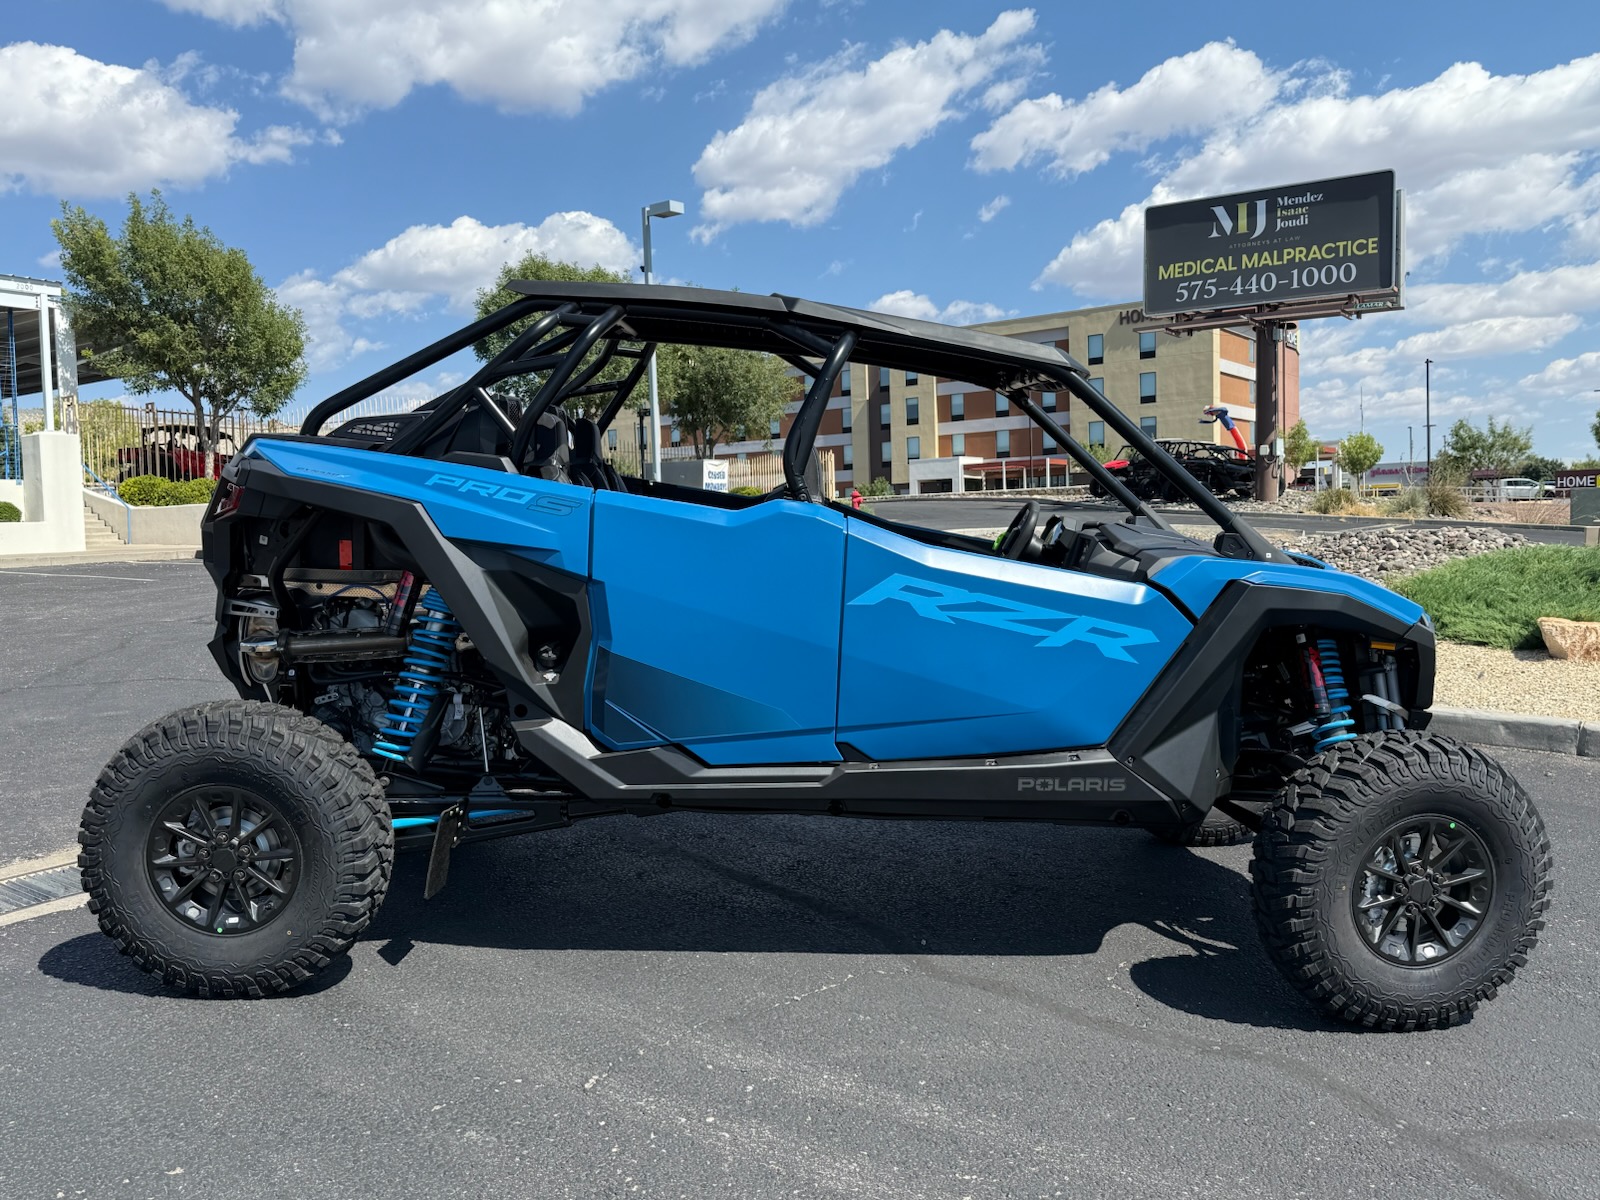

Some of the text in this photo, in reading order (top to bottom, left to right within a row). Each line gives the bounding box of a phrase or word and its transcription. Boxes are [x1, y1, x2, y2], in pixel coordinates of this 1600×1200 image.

[1276, 192, 1324, 207] Mendez
[1277, 206, 1309, 217] Isaac
[1275, 214, 1309, 232] Joudi
[1228, 239, 1270, 249] ATTORNEYS
[1158, 237, 1379, 280] MEDICAL MALPRACTICE
[1175, 262, 1357, 302] 575-440-1000
[1356, 301, 1384, 309] LAMAR
[1557, 475, 1596, 487] HOME
[424, 473, 537, 505] PRO
[846, 573, 1160, 664] RZR
[1017, 777, 1127, 792] POLARIS
